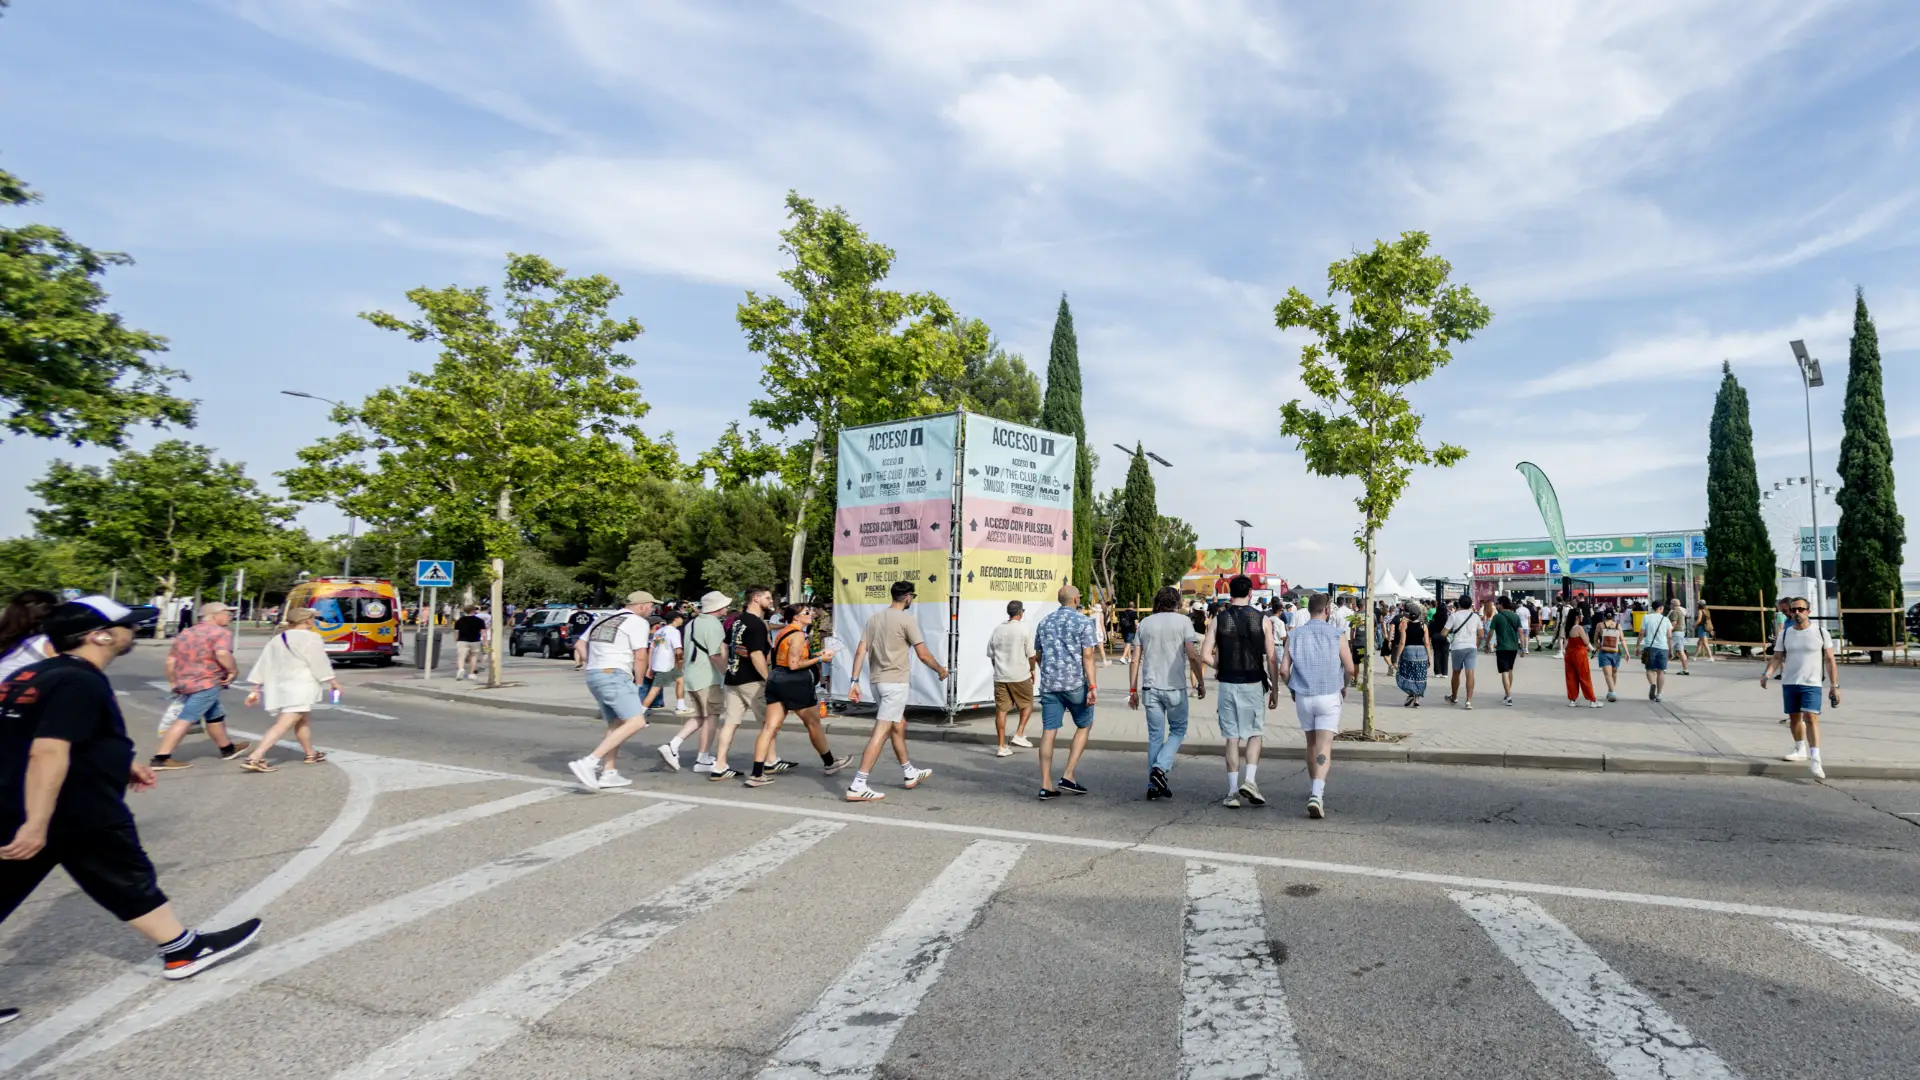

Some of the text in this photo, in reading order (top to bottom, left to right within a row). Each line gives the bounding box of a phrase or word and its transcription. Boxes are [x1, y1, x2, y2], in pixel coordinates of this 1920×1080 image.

[868, 430, 907, 452] ACCESO
[992, 426, 1038, 453] ACCESO
[1012, 458, 1028, 467] ACCESO
[861, 473, 872, 483] VIP
[985, 465, 1000, 477] VIP
[1006, 469, 1018, 480] THE
[1020, 471, 1037, 483] CLUB
[880, 482, 900, 490] PRENSA
[984, 478, 1005, 494] SMUSIC
[1011, 483, 1035, 492] PRENSA
[1040, 487, 1060, 496] MAD
[1011, 489, 1033, 498] PRESS
[860, 522, 879, 534] ACCESO
[893, 519, 917, 531] PULSERA
[984, 517, 1053, 534] ACCESO CON PULSERA
[860, 536, 877, 547] ACCESS
[986, 531, 1054, 547] ACCESS WITH WRISTBAND
[1801, 536, 1827, 544] ACCSO
[1566, 540, 1613, 552] CCESO
[1802, 544, 1829, 552] ACCSS
[1007, 556, 1024, 564] ACCESO
[980, 566, 1013, 578] RECOGIDA
[1014, 568, 1023, 579] DE
[1024, 568, 1053, 580] PULSERA
[1474, 562, 1514, 575] FAST TRACK
[856, 572, 868, 582] VIP
[873, 572, 883, 582] THE
[884, 571, 898, 582] CLUB
[990, 580, 1047, 593] WRISTBAND PICK UP
